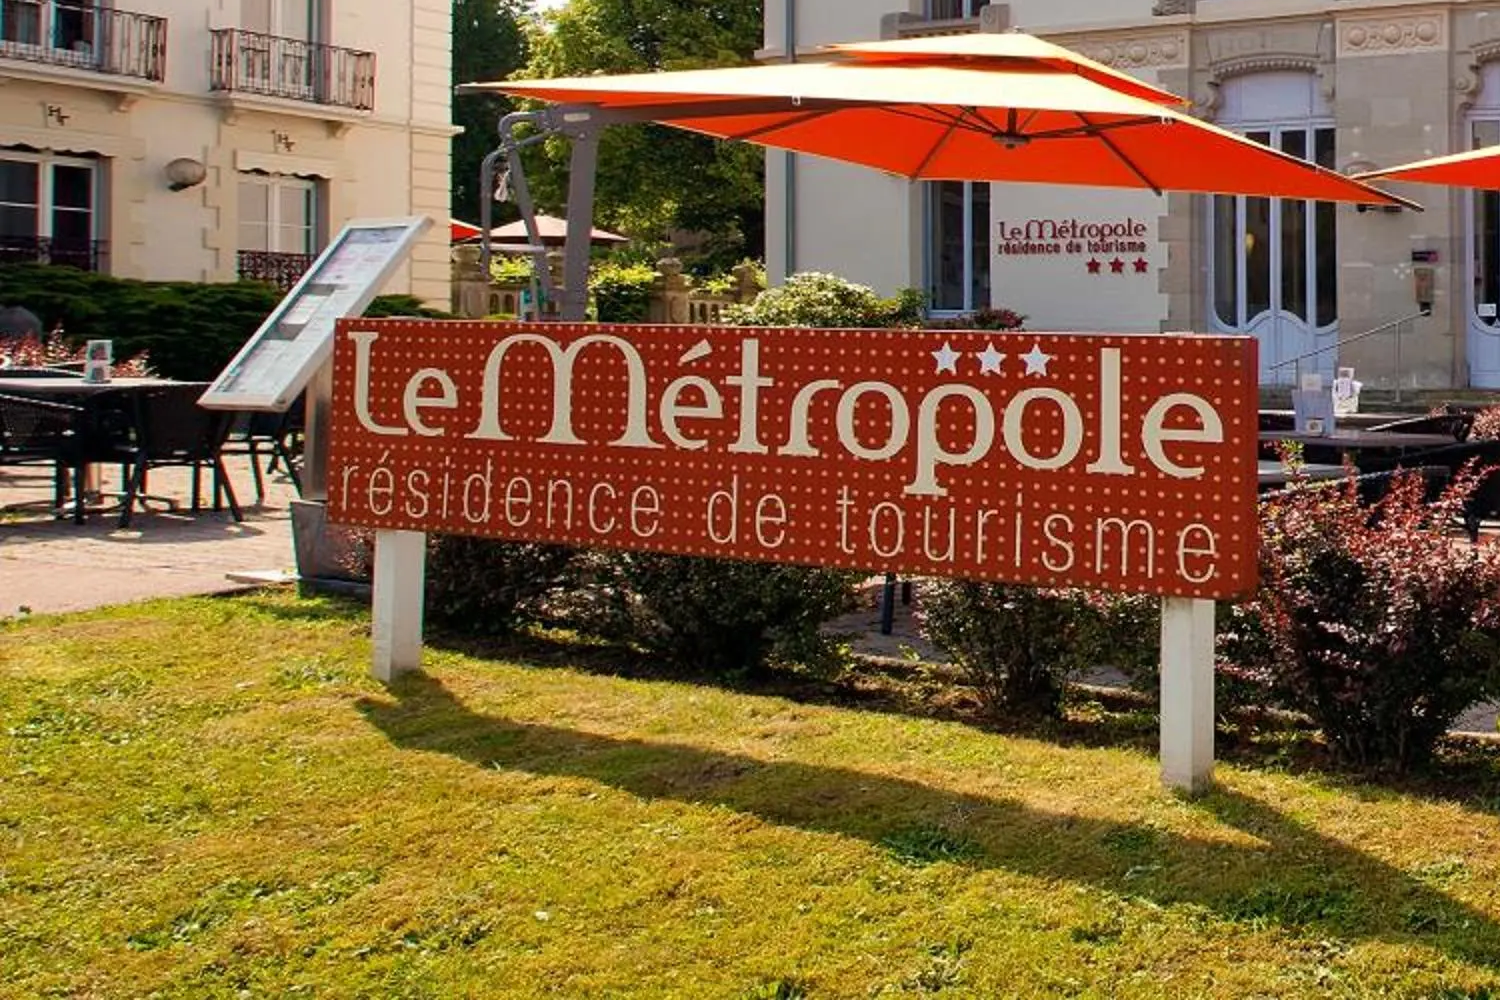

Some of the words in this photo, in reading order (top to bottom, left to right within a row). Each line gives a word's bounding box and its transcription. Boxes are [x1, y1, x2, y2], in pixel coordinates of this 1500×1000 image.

[998, 239, 1061, 255] résidence
[1066, 240, 1082, 253] de
[1087, 239, 1146, 253] tourisme
[1025, 217, 1147, 242] Métropole
[346, 330, 460, 438] Le
[463, 332, 1225, 497] Métropole
[339, 449, 661, 538] résidence
[706, 477, 788, 550] de
[840, 486, 1218, 585] tourisme
